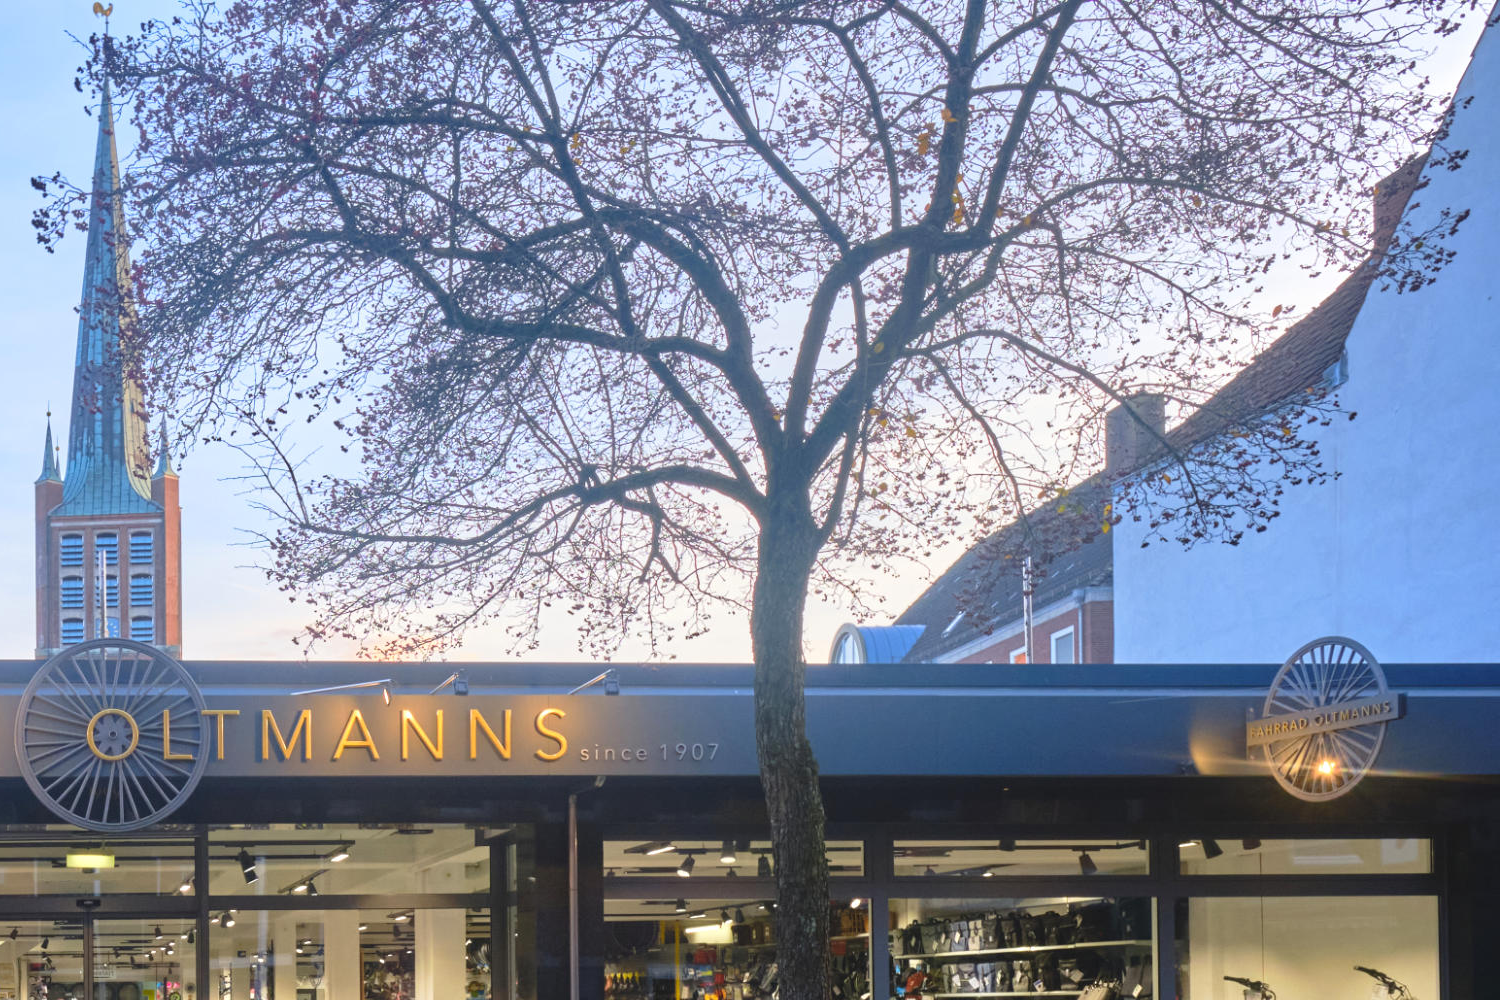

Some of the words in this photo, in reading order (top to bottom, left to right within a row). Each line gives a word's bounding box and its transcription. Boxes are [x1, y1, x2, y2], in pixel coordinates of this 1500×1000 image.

[86, 708, 569, 762] OLTMANNS
[1250, 717, 1308, 738] FAHRRAD
[1315, 700, 1391, 726] OLTMANNS
[580, 743, 648, 761] since
[660, 742, 719, 761] 1907
